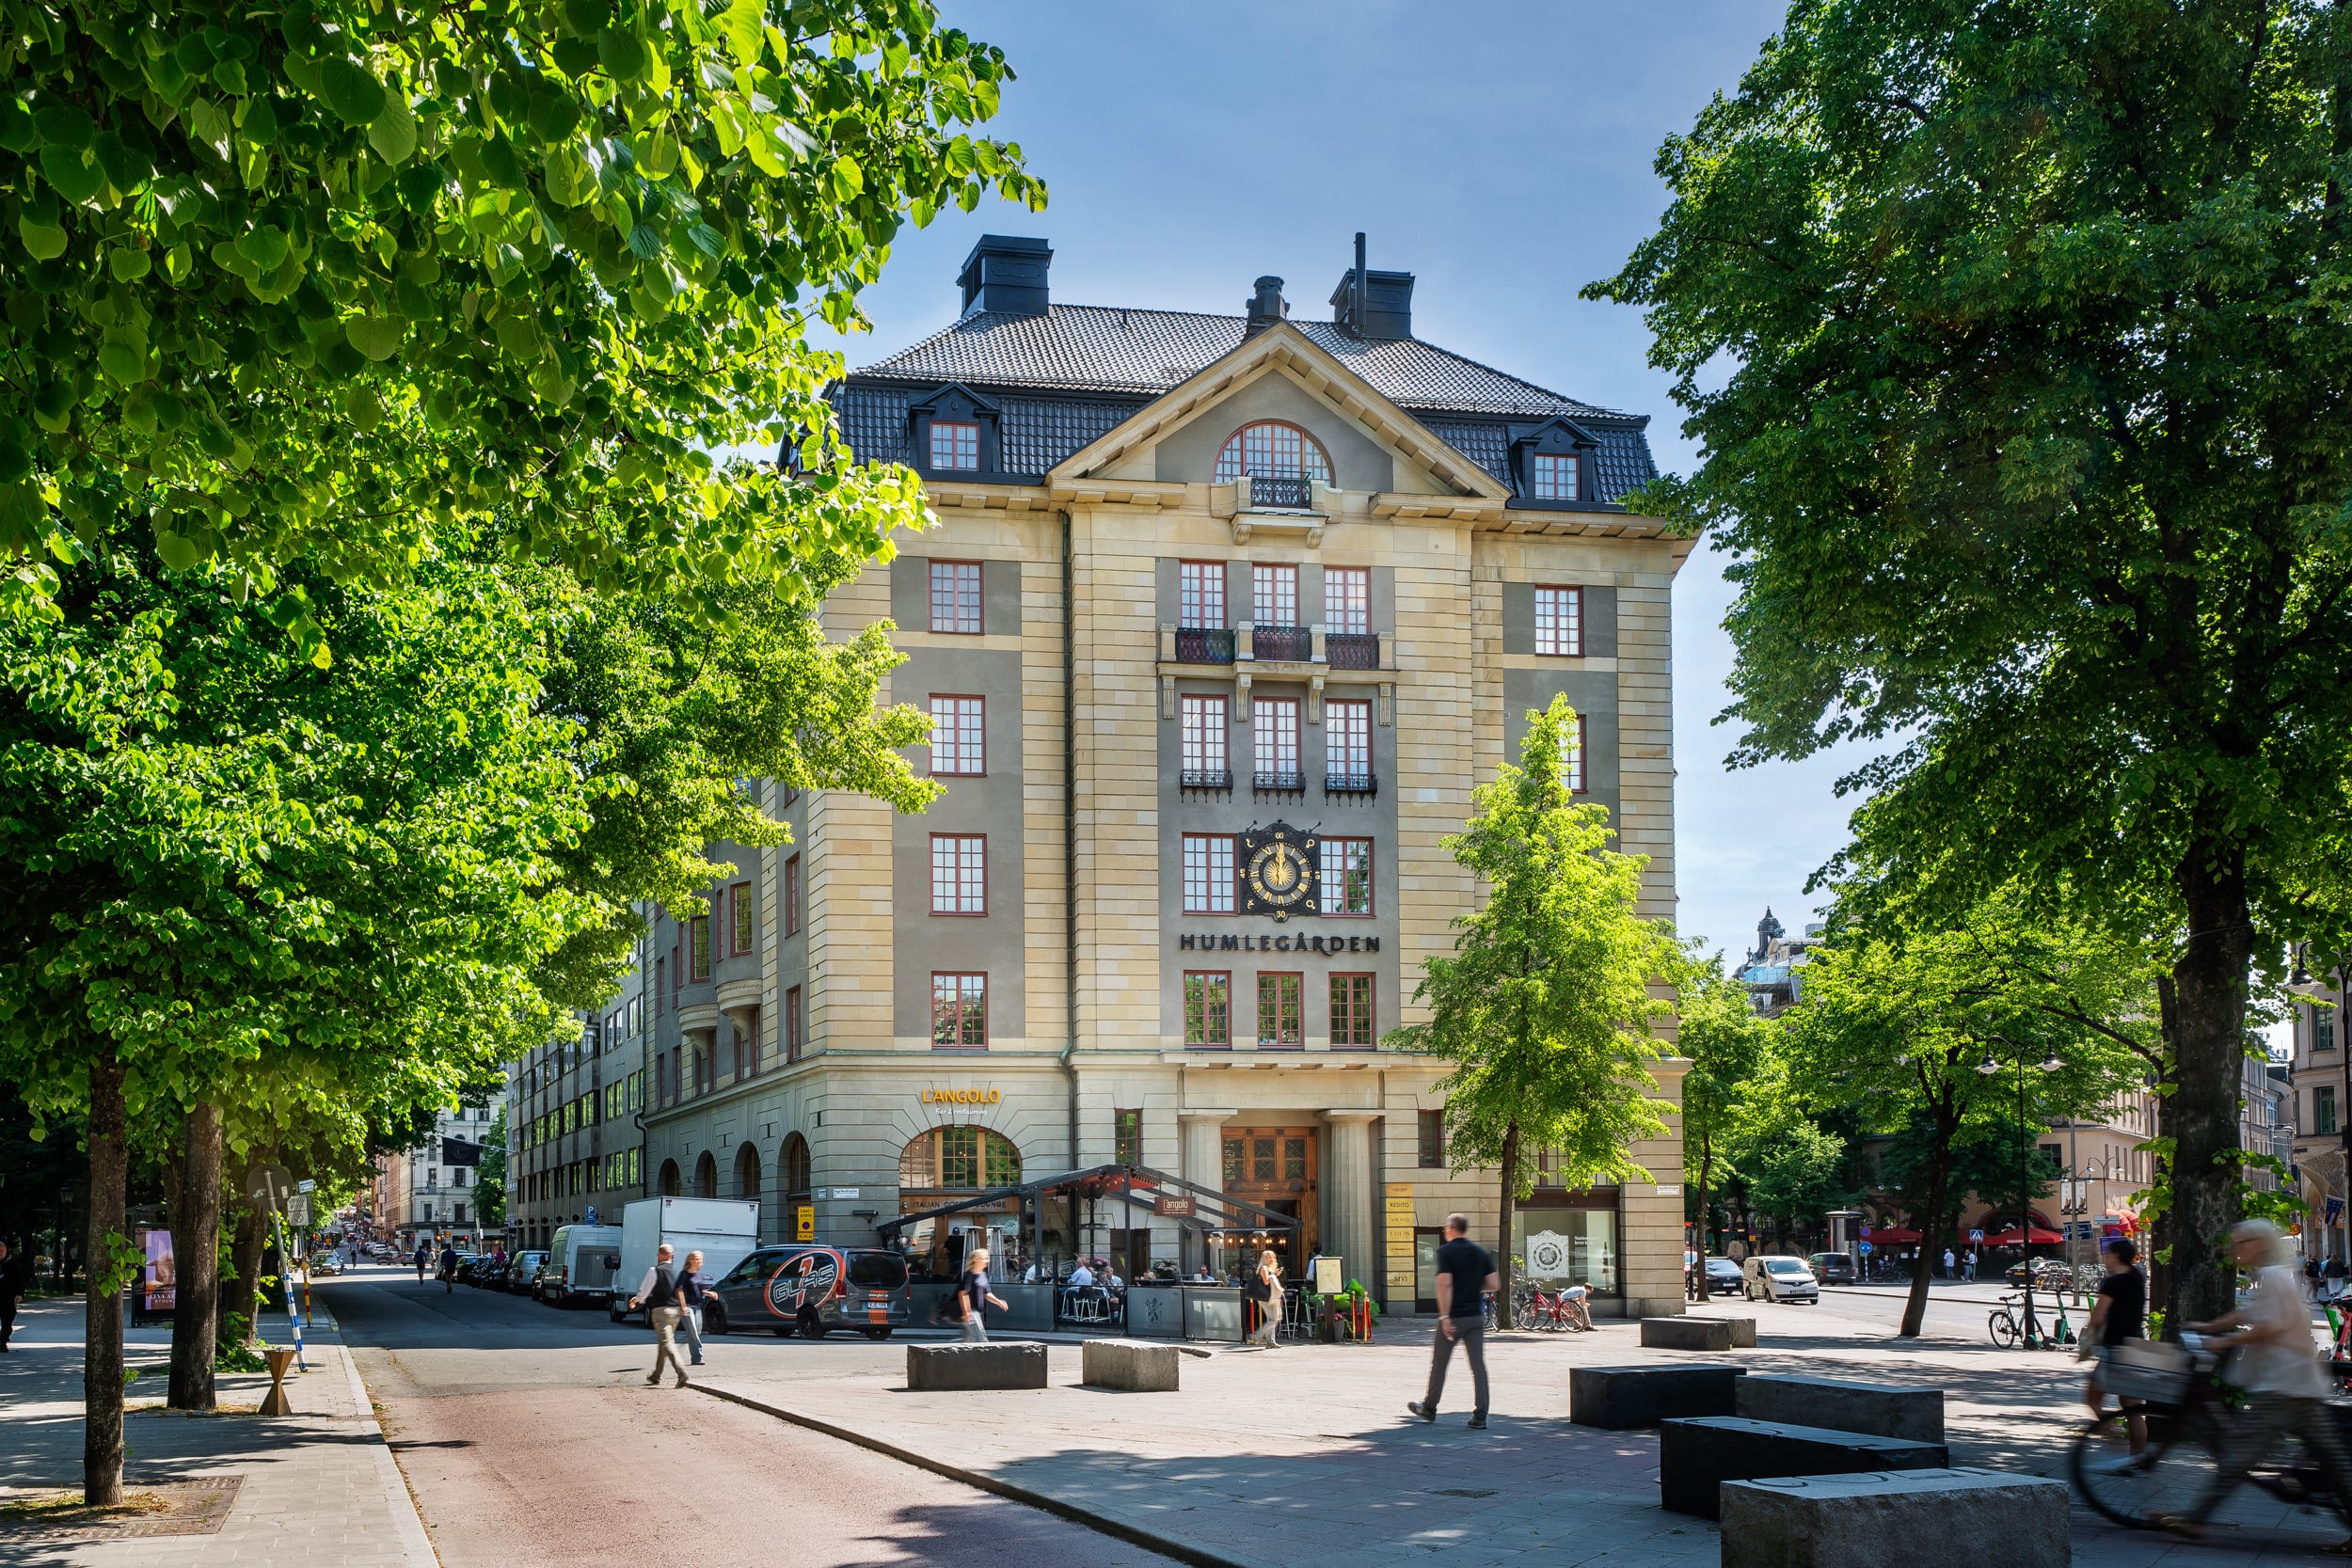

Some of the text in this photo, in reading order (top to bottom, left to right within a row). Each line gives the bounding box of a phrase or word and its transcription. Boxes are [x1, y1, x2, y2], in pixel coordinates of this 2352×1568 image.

[1276, 910, 1286, 918] 30
[1180, 931, 1380, 956] HUMLEGÅRDEN
[587, 1206, 595, 1214] P
[772, 1263, 834, 1304] GLAS
